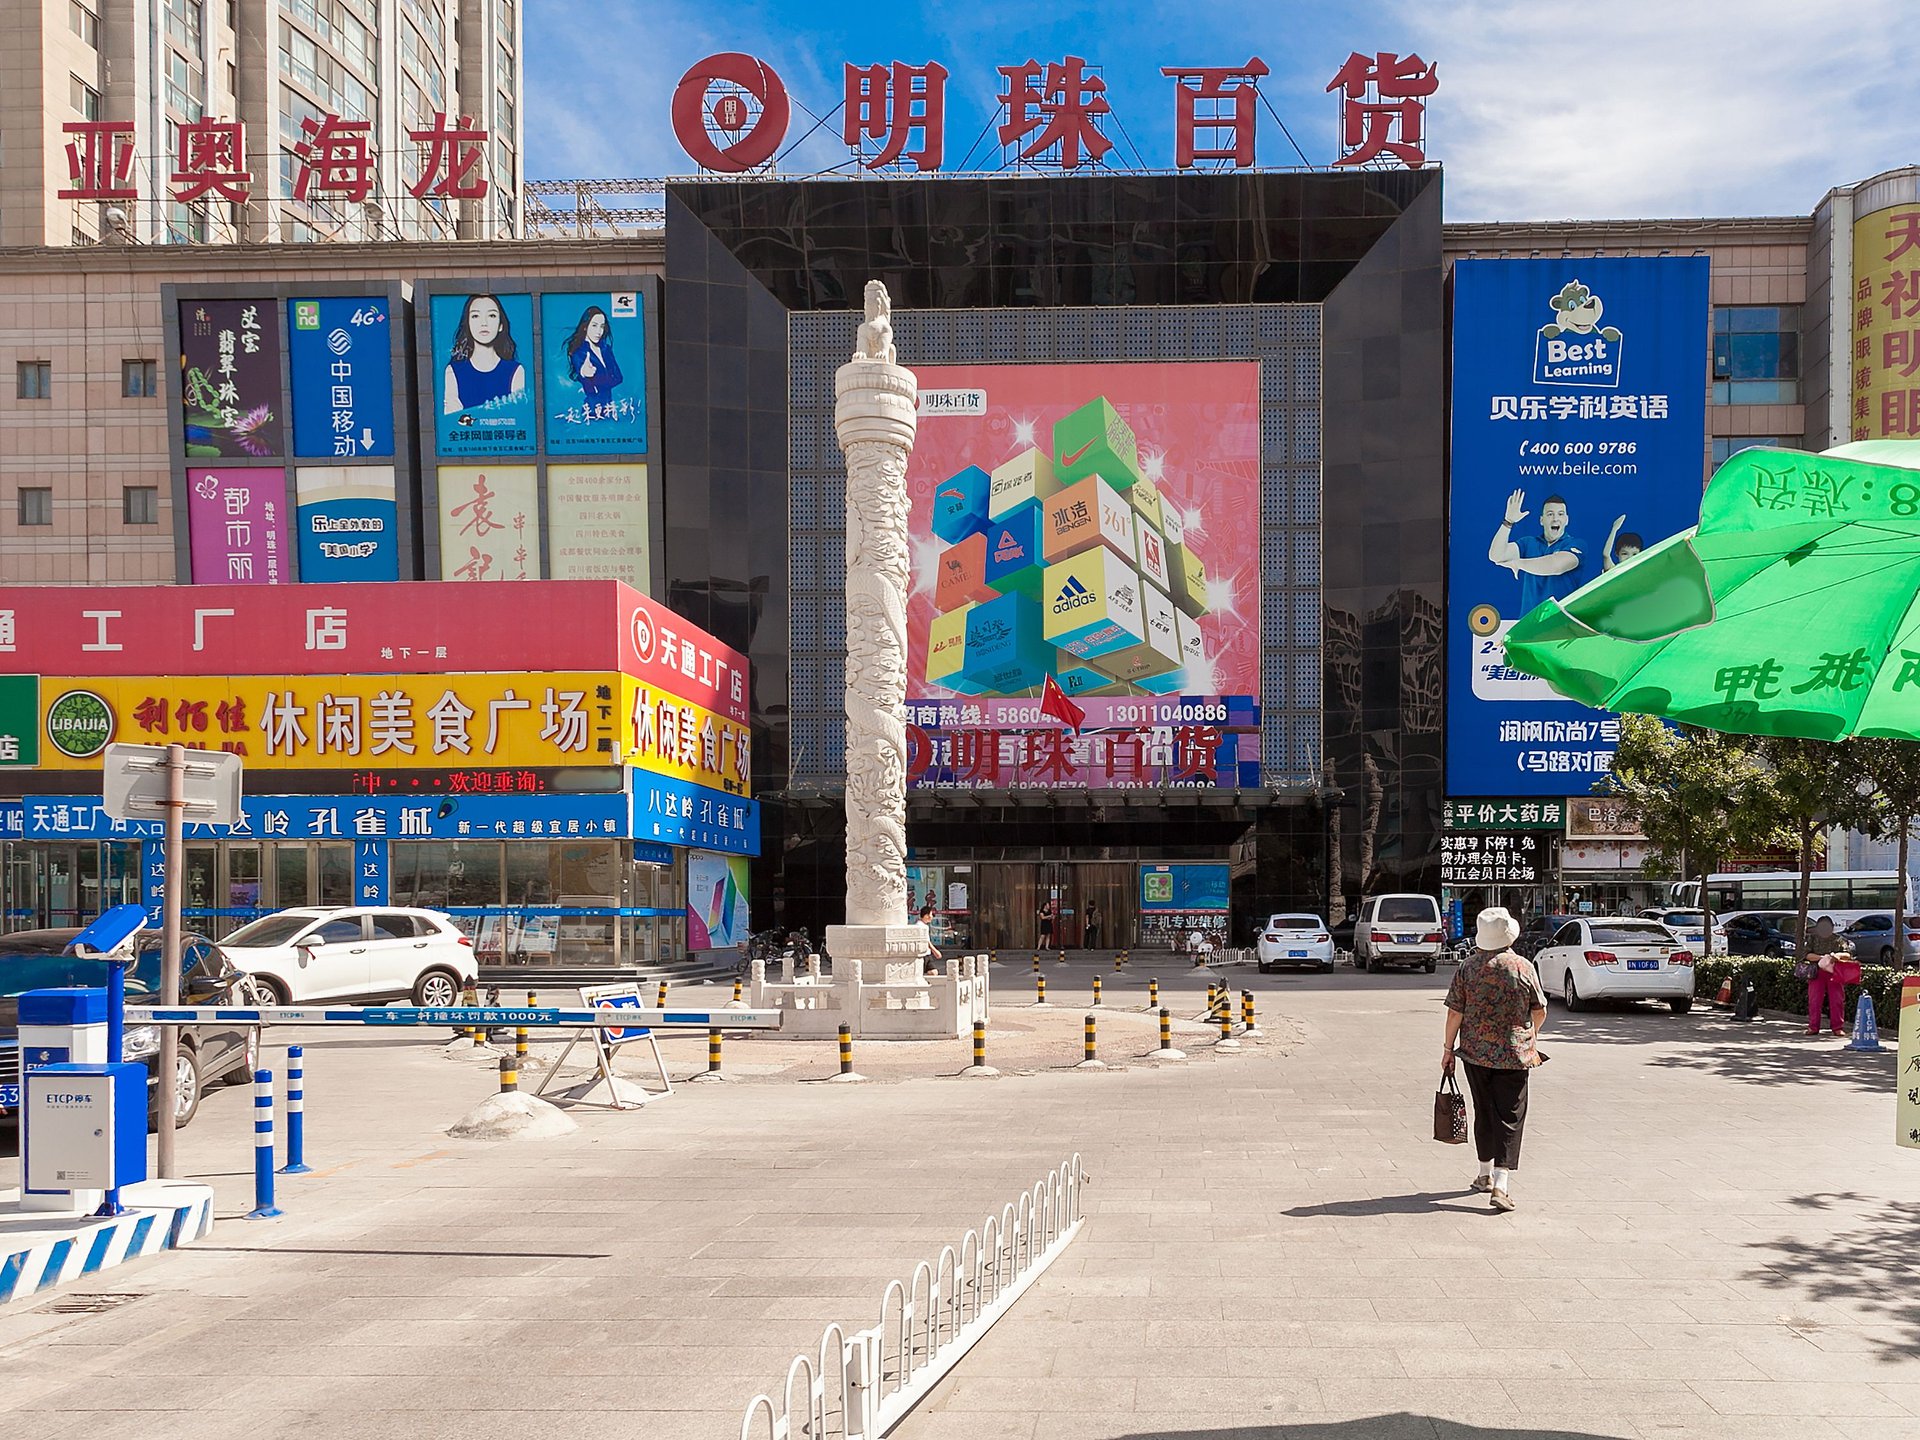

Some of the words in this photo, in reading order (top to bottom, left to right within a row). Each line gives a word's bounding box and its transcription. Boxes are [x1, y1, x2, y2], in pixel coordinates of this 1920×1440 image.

[844, 52, 1440, 171] 明珠百货
[58, 111, 489, 204] 亚奥海龙
[350, 308, 375, 327] 4G
[1547, 338, 1607, 363] Best
[1544, 363, 1612, 378] Learning
[331, 360, 355, 456] 中国移动
[925, 393, 980, 408] 明珠百货
[1490, 395, 1669, 420] 贝乐学科英语
[1530, 443, 1560, 455] 400
[1564, 443, 1593, 455] 600
[1598, 442, 1637, 455] 9786
[1519, 461, 1638, 476] www.beile.com
[1052, 500, 1088, 528] 冰洁
[1053, 592, 1097, 614] adidas
[381, 646, 448, 660] 地下一层
[660, 627, 742, 703] 天通工厂店
[133, 695, 250, 735] 利佰佳
[259, 687, 589, 756] 休闲美食广场
[596, 685, 613, 753] 地下一层
[1106, 704, 1227, 722] 13011040886
[51, 718, 109, 731] LIBAIJIA
[631, 687, 750, 782] 休闲美食广场
[950, 726, 1223, 782] 明珠百货
[1443, 800, 1454, 827] 天保堂
[1456, 803, 1561, 824] 平价大药房
[133, 822, 164, 836] 入口
[458, 819, 617, 834] 新一代超级宜居小镇
[362, 842, 380, 900] 八达岭
[1440, 866, 1536, 881] 周五会员日全场
[1144, 915, 1227, 929] 手机专业维修
[46, 1094, 93, 1105] ETCP停车
